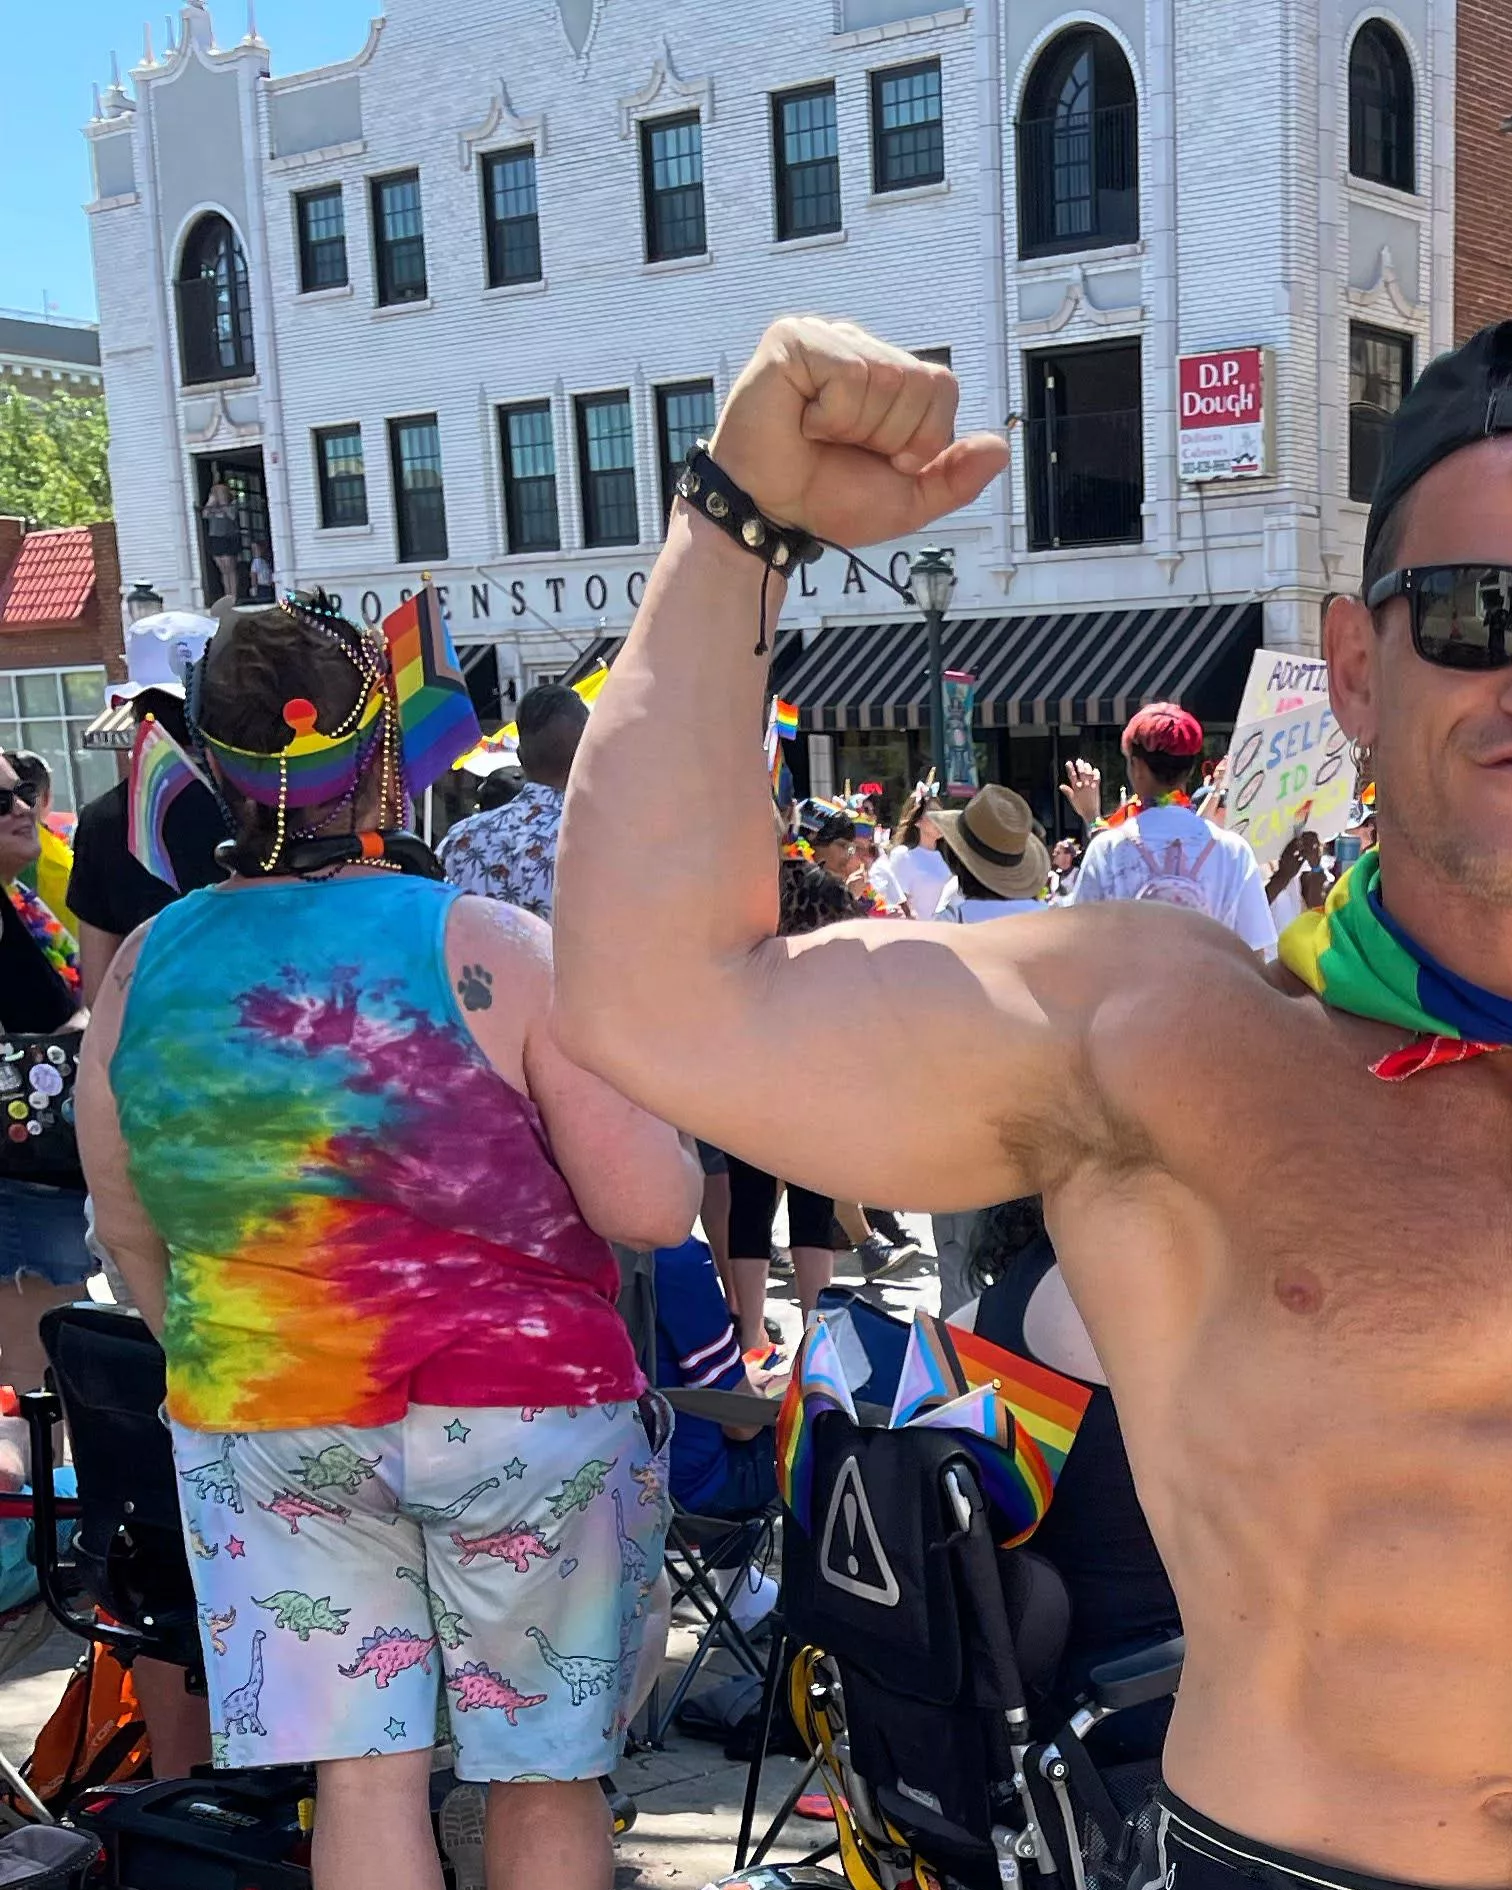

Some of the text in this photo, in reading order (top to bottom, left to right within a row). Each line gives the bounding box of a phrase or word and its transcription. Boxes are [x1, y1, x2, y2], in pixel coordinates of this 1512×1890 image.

[1199, 360, 1240, 389] D.P.
[1182, 384, 1254, 418] Dough
[1265, 709, 1334, 771] SELF
[1276, 763, 1309, 800] ID
